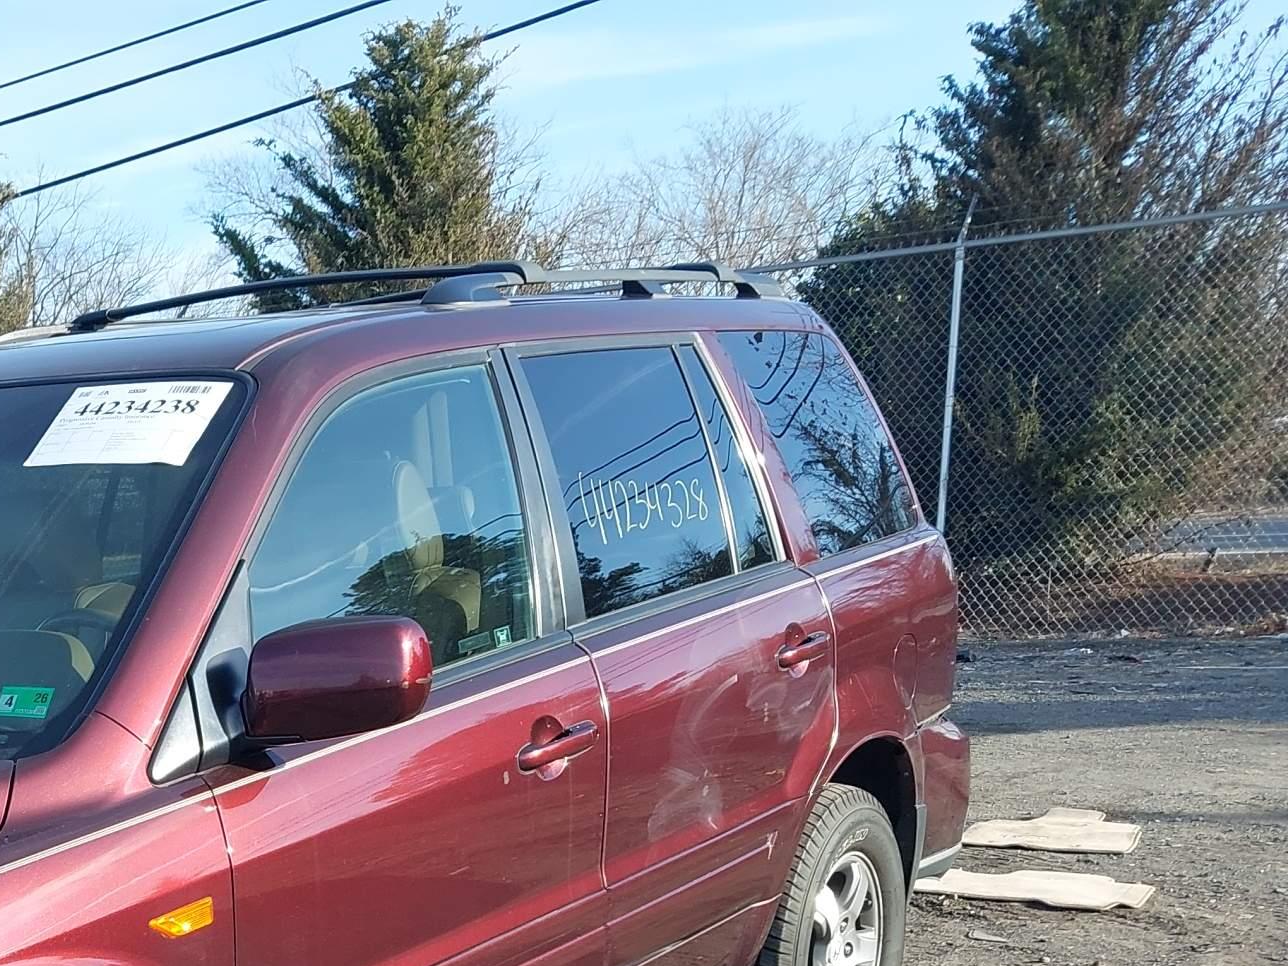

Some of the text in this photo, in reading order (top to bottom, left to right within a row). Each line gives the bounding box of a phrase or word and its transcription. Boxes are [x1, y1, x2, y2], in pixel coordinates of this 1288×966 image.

[74, 399, 200, 417] 44234238
[578, 471, 709, 544] 44234328
[4, 696, 14, 708] 4
[33, 693, 48, 704] 26
